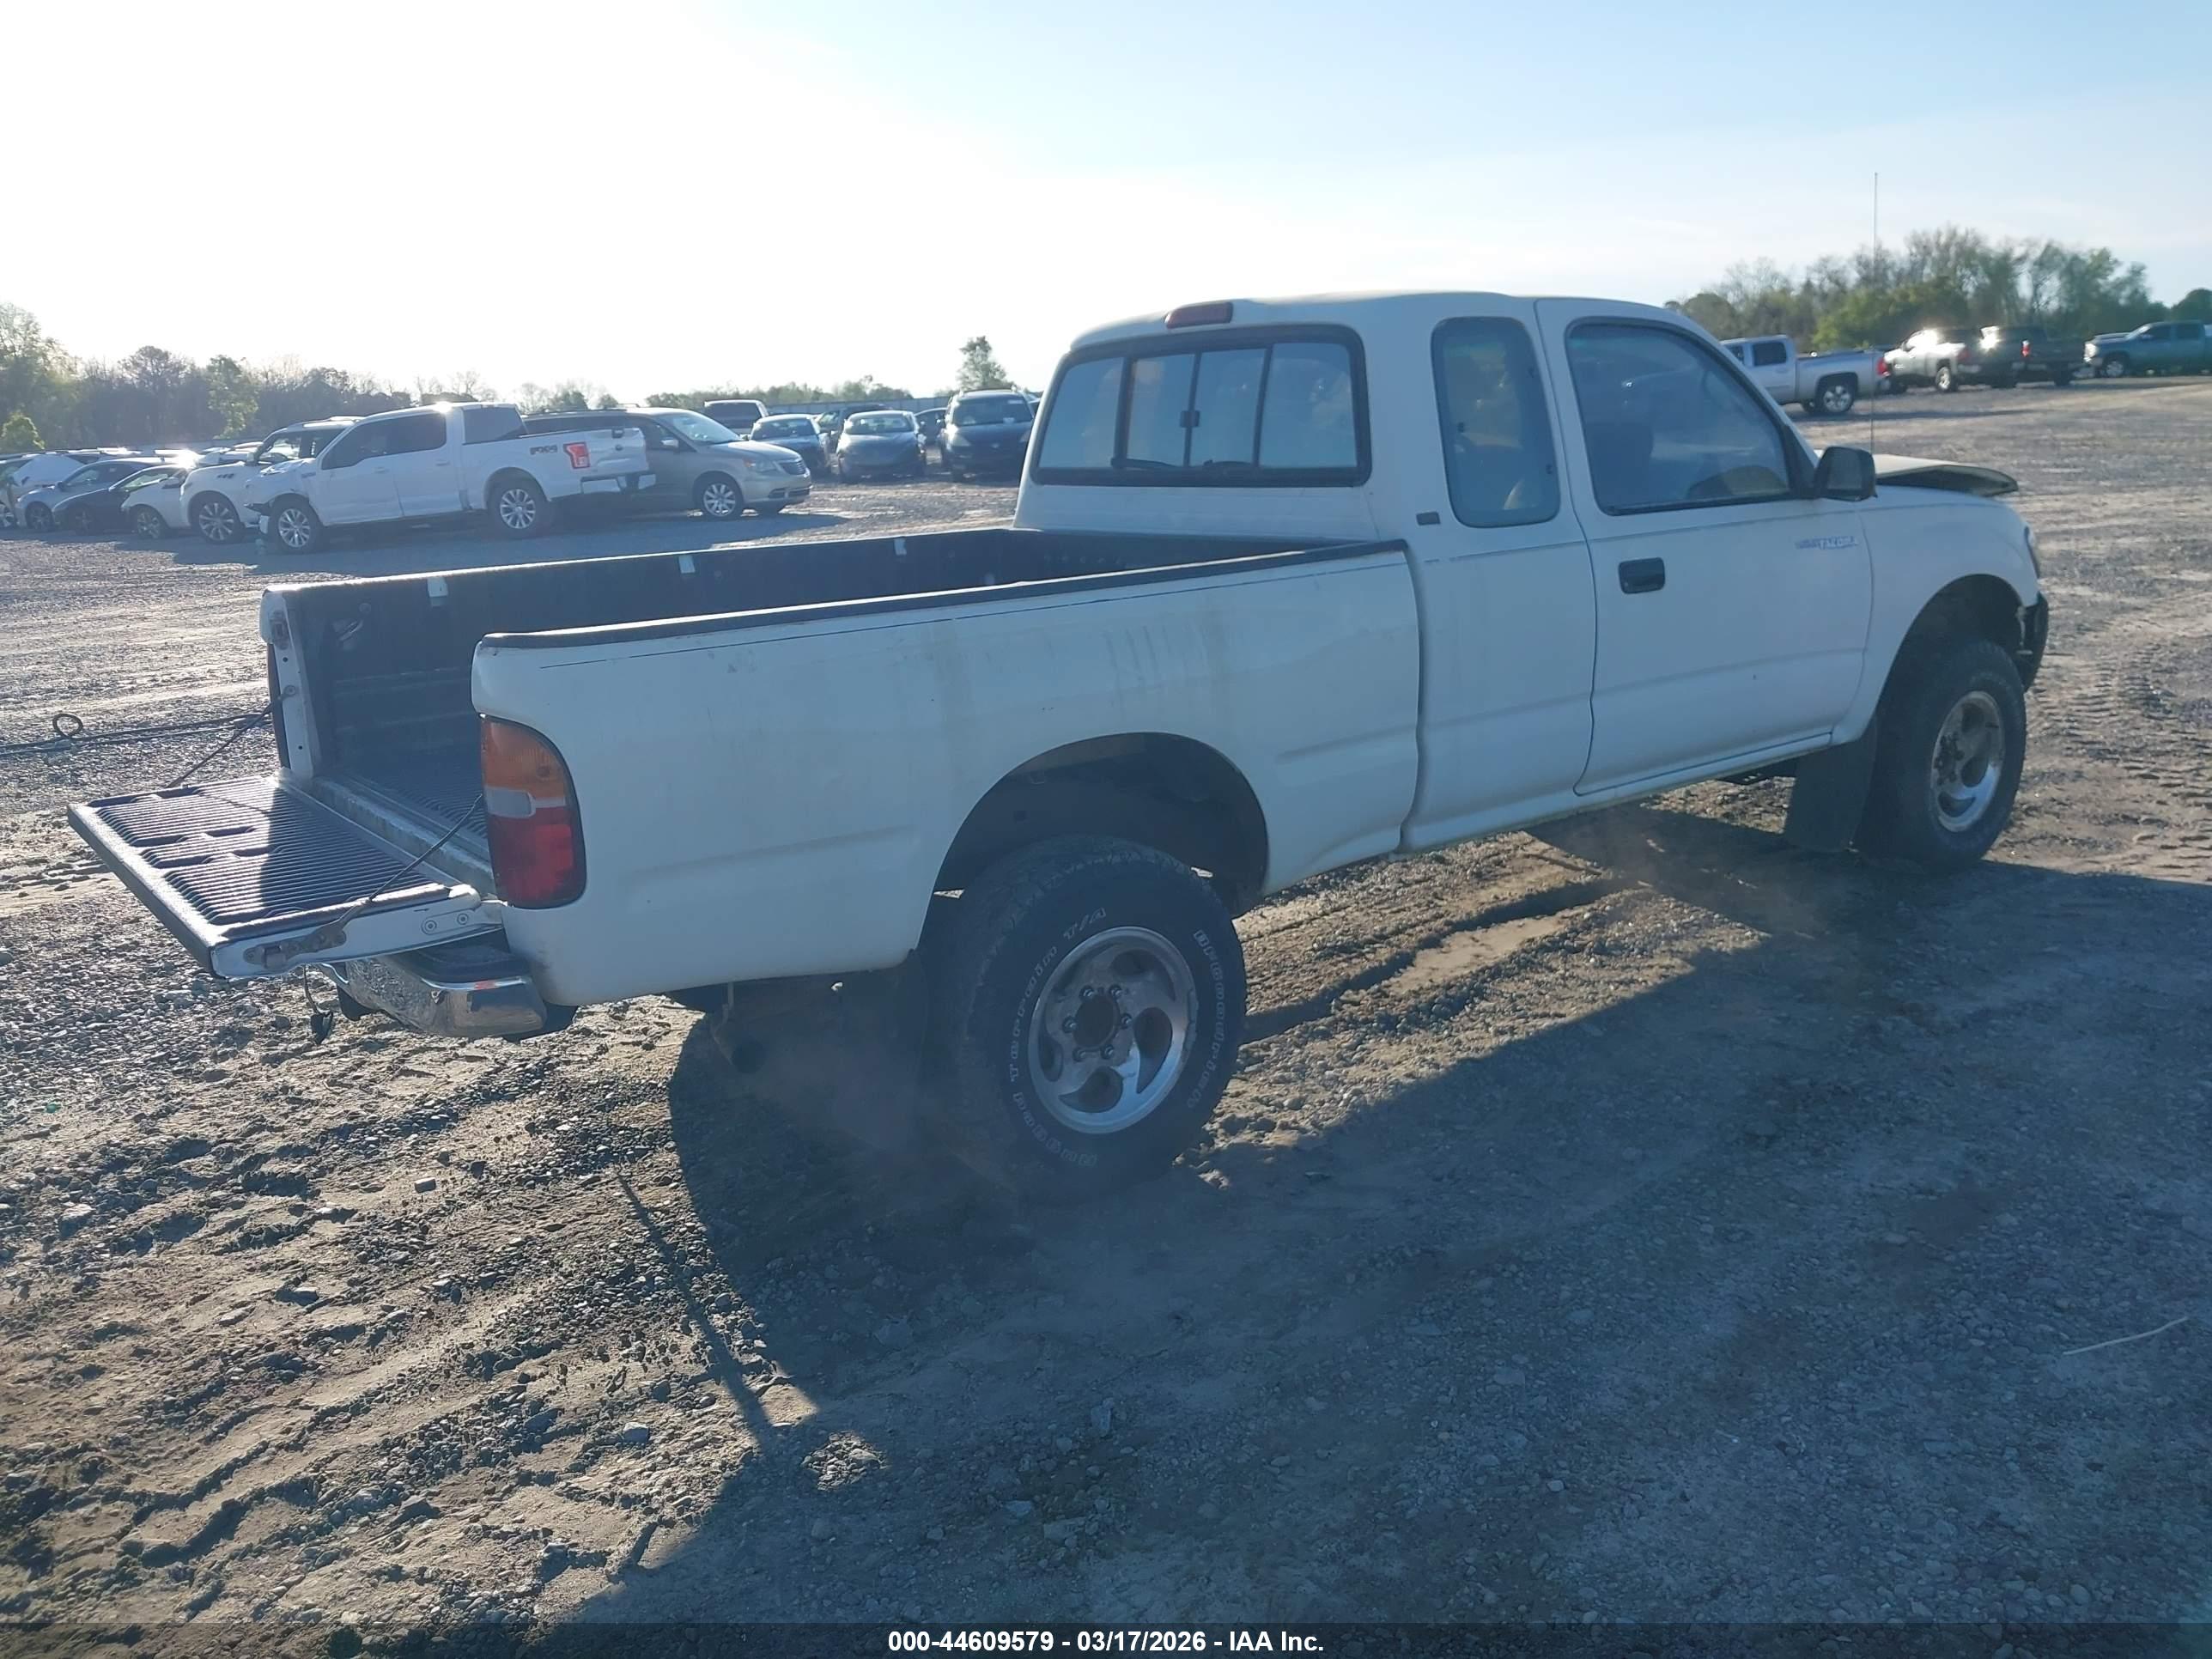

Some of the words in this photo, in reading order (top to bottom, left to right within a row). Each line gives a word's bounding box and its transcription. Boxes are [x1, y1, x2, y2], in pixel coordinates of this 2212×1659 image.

[1009, 945, 1059, 1083] Terrain
[1062, 907, 1107, 941] T/A
[1186, 928, 1226, 1109] BFGoodrich
